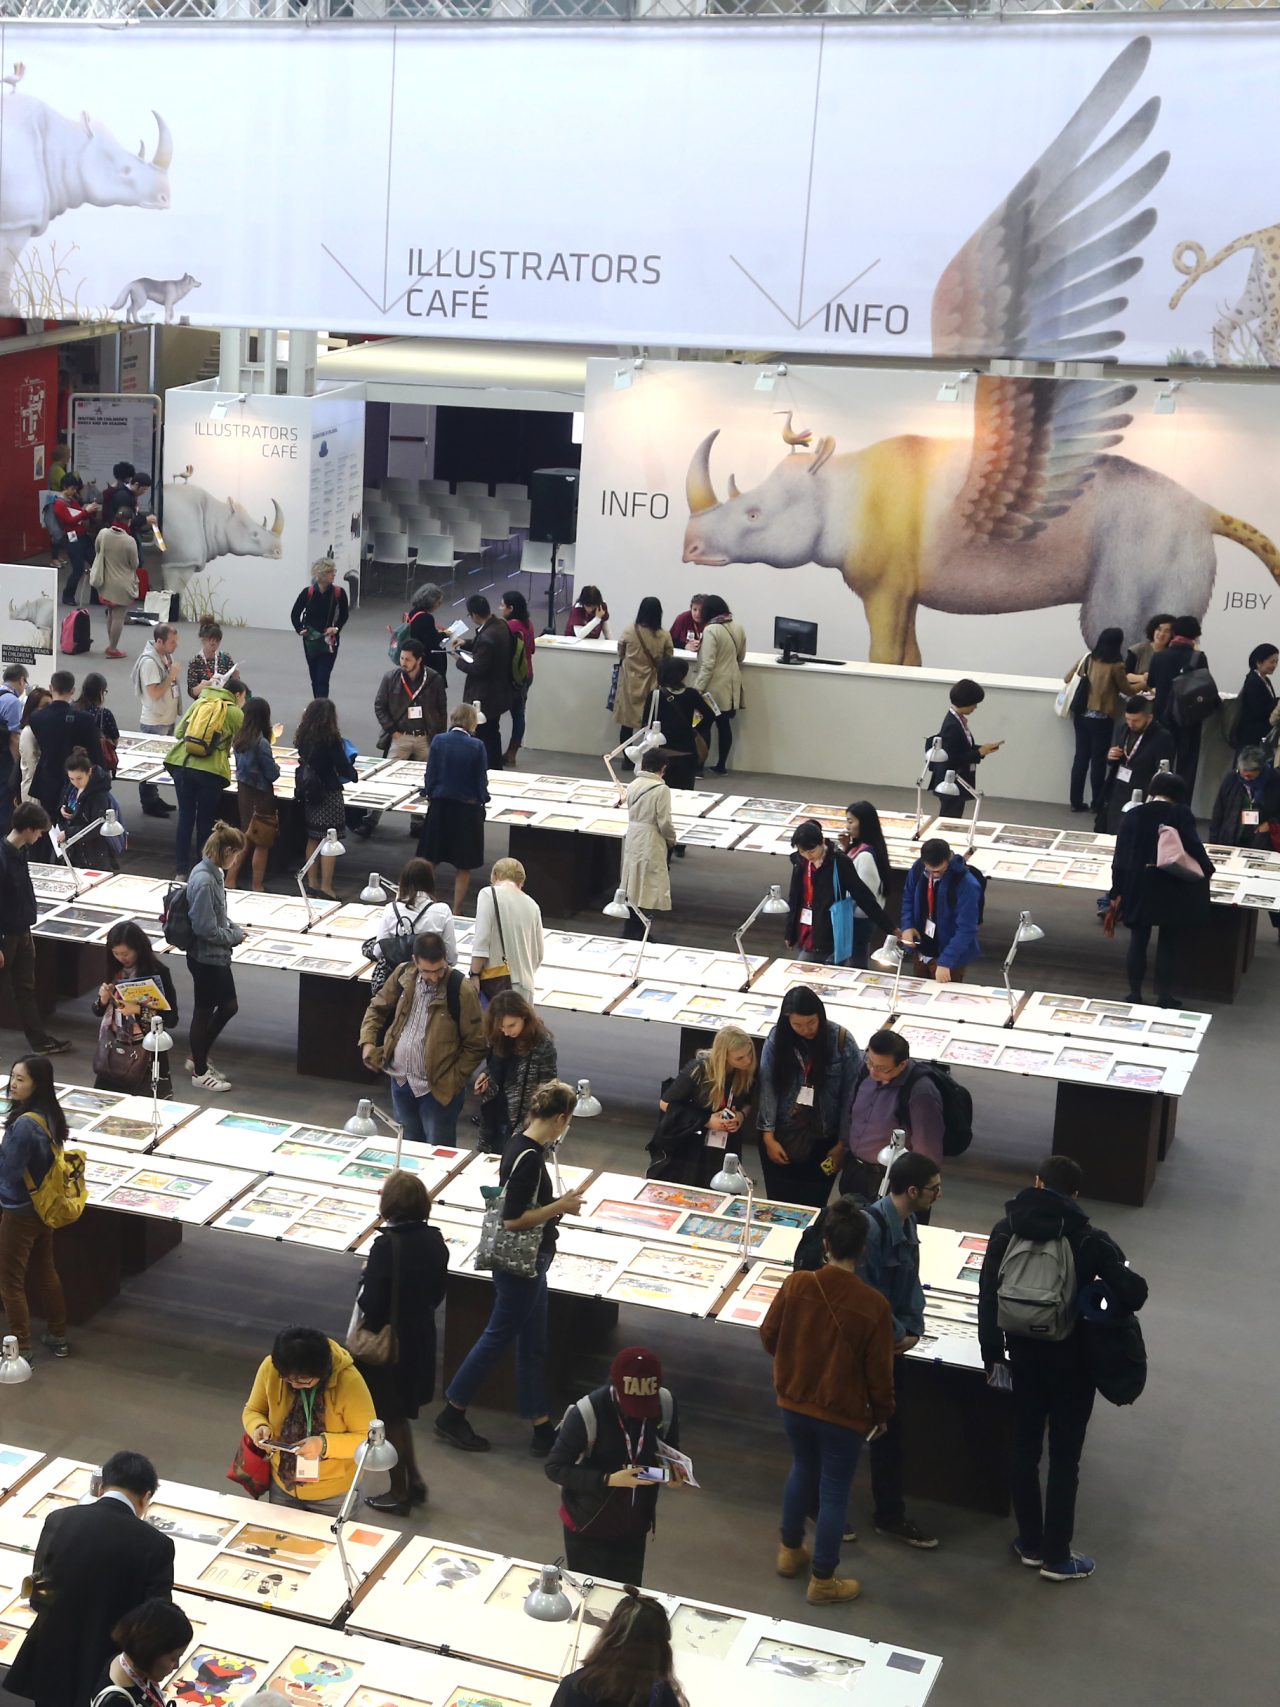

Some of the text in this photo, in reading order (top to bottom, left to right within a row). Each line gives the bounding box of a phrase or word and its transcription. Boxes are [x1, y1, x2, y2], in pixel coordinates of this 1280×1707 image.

[407, 247, 662, 285] ILLUSTRATORS
[406, 284, 489, 319] CAFÉ
[824, 302, 909, 335] INFO
[194, 421, 298, 442] ILLUSTRATORS
[601, 490, 669, 519] INFO
[1223, 591, 1272, 611] JBBY
[622, 1376, 658, 1396] TAKE
